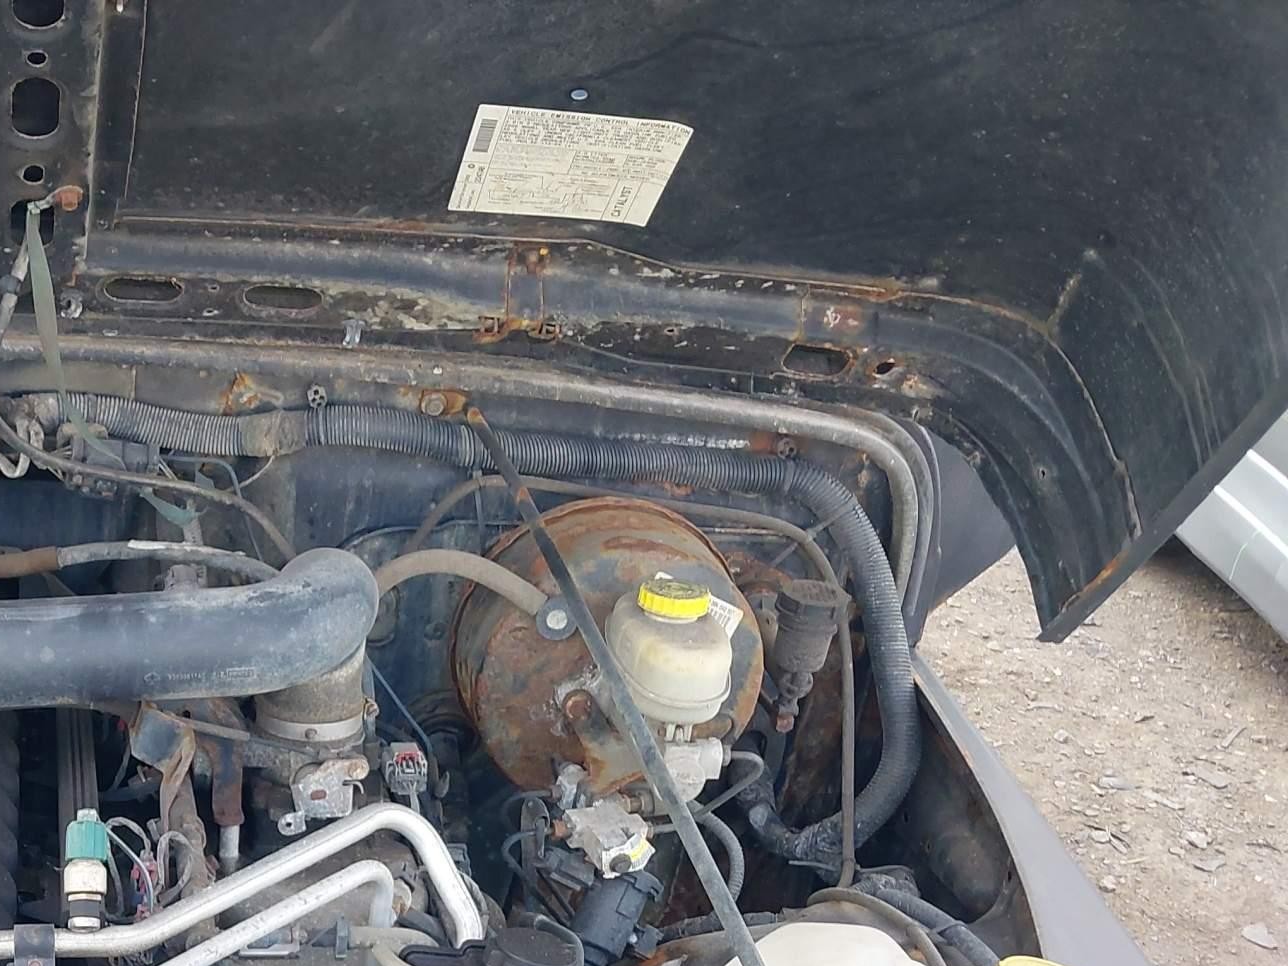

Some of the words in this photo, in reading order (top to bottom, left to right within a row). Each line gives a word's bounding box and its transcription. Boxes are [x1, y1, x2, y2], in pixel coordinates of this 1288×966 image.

[511, 109, 546, 117] VEHICLE
[550, 112, 592, 121] EMISSION
[595, 115, 629, 126] CONTROL
[635, 120, 691, 136] INFORMATION
[610, 185, 633, 217] CATALYST
